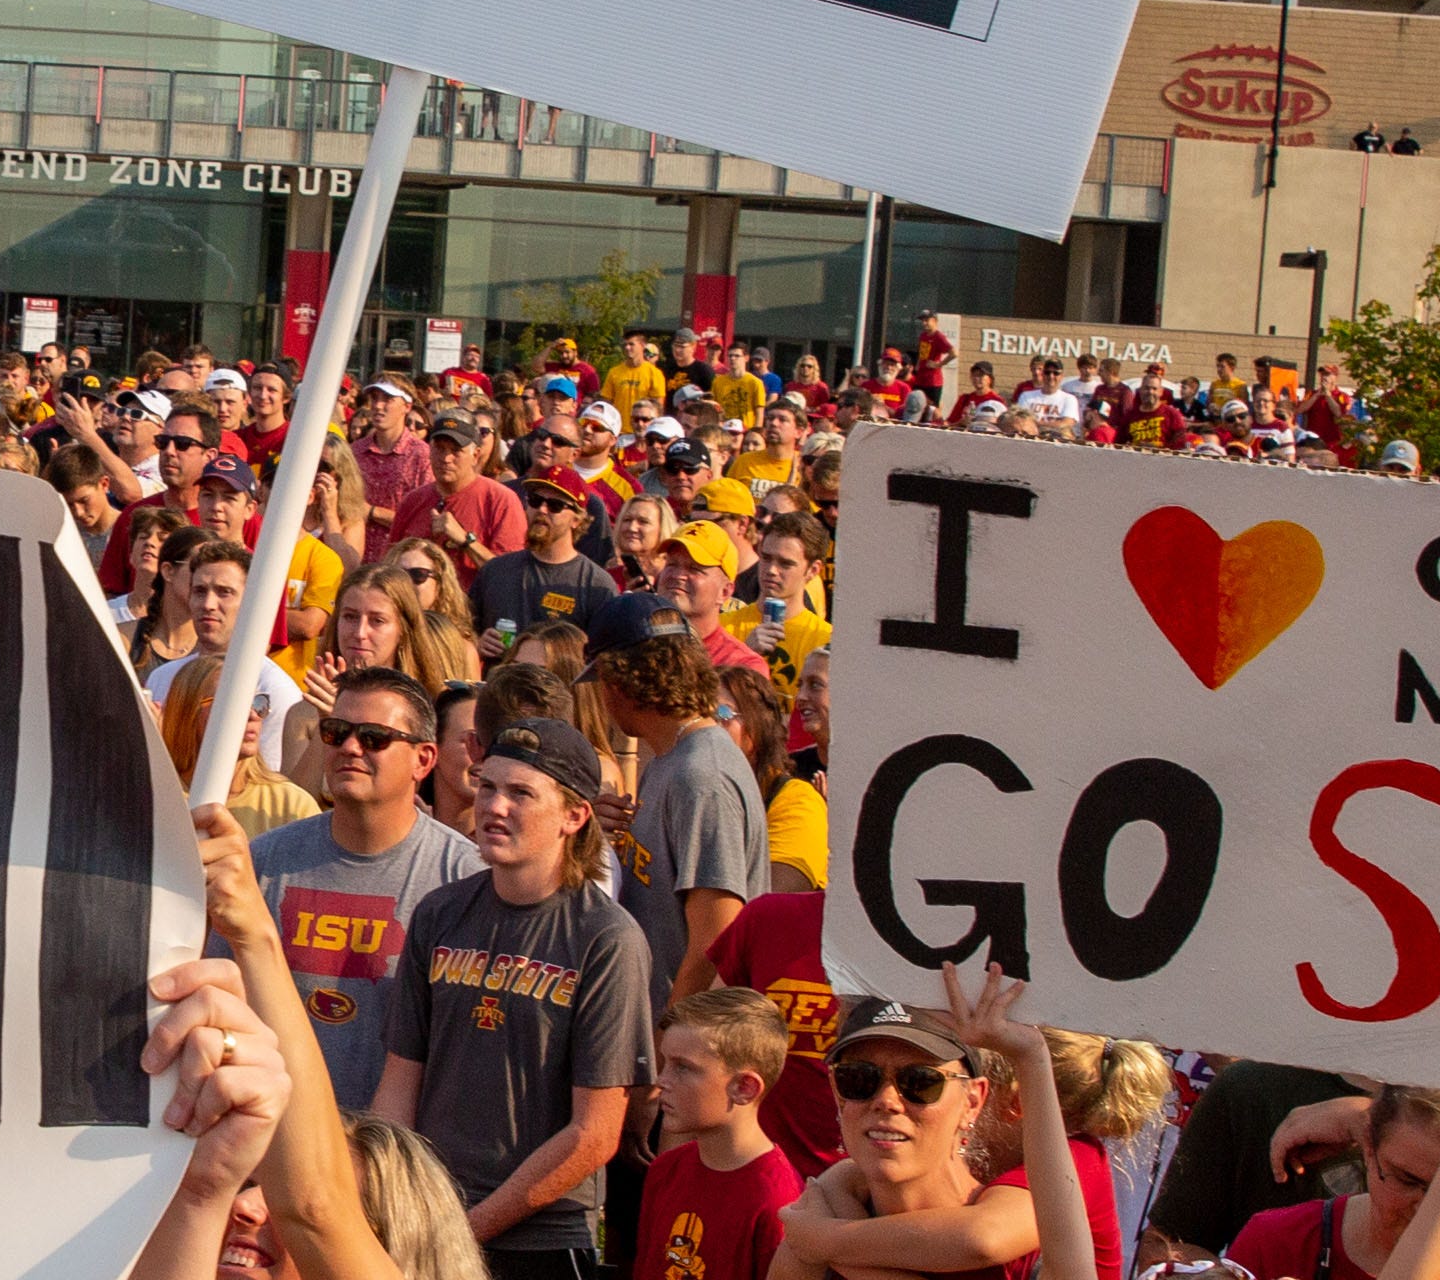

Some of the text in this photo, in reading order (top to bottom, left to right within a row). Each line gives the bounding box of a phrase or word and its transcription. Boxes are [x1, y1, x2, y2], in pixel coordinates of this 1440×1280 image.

[1, 149, 89, 183] END
[108, 158, 224, 192] ZONE
[242, 165, 354, 199] CLUB
[981, 328, 1173, 364] REIMAN PLAZA
[878, 468, 1039, 663] I
[851, 732, 1224, 985] GO
[291, 908, 389, 955] ISU
[484, 953, 580, 1009] STATE
[871, 1011, 912, 1026] adidas
